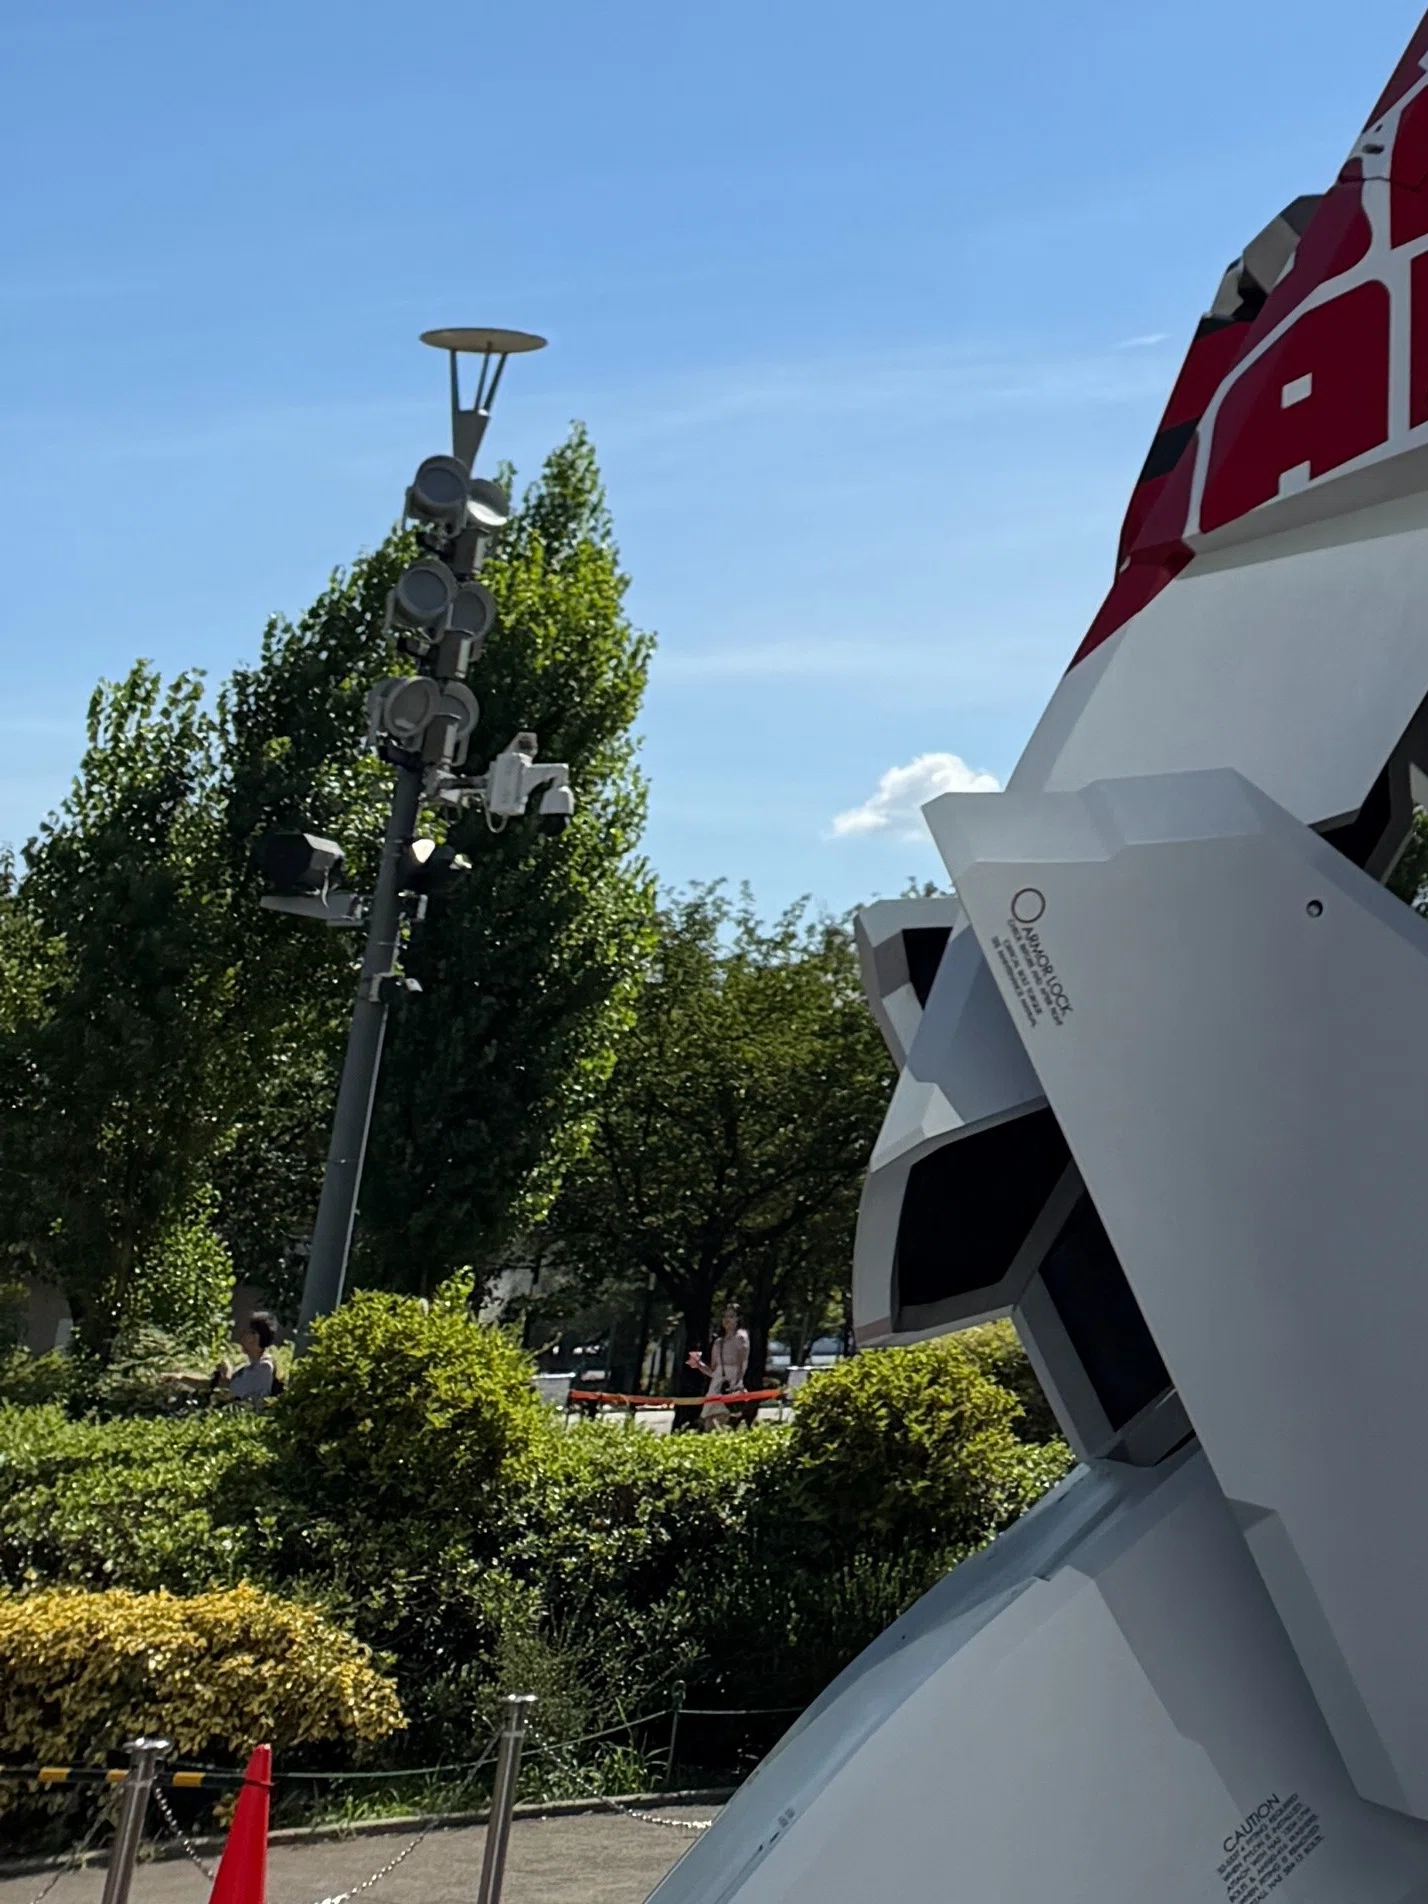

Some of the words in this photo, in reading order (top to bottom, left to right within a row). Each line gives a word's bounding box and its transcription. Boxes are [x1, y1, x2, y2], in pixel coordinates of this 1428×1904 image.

[1021, 926, 1055, 977] ARMOR
[1046, 975, 1074, 1017] LOCK
[1223, 1792, 1281, 1852] CAUTION
